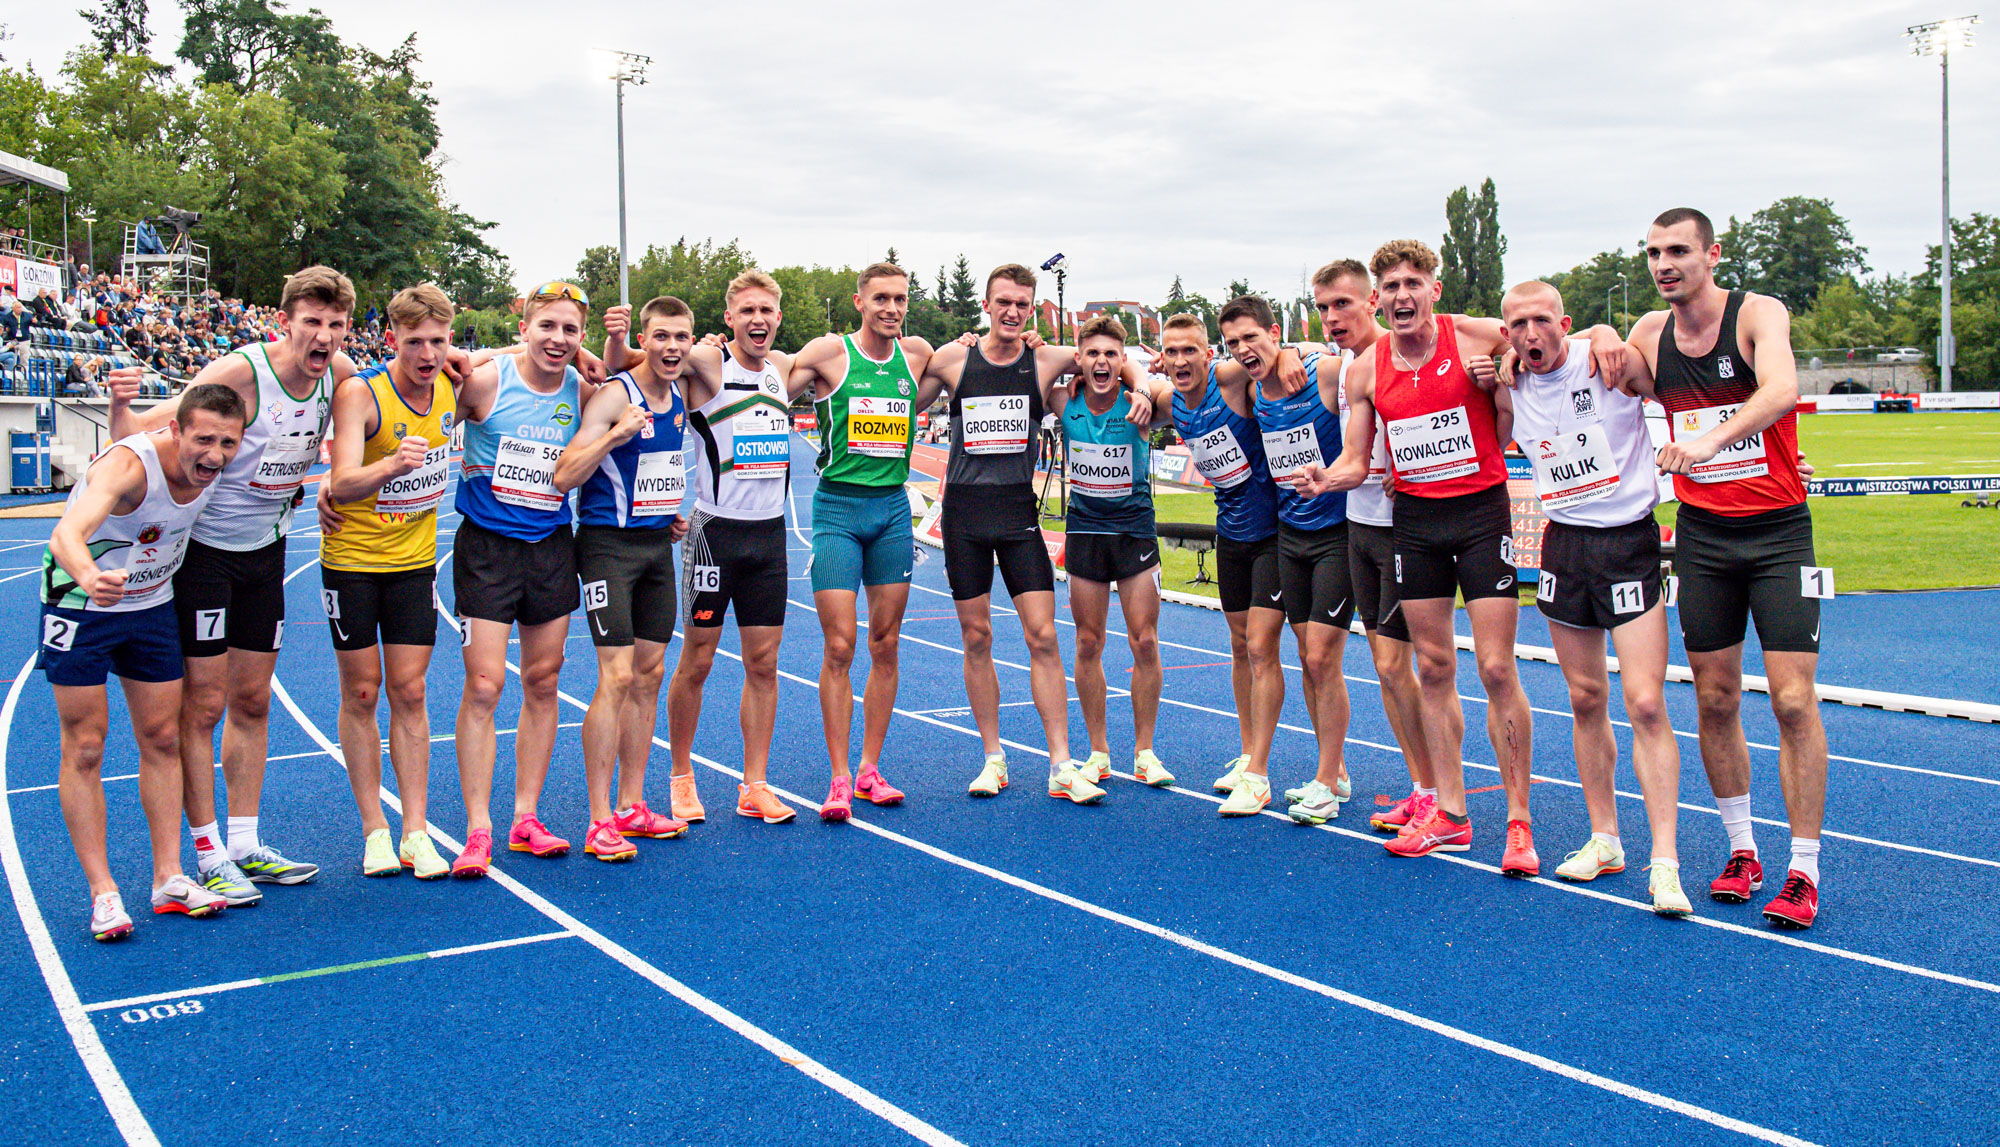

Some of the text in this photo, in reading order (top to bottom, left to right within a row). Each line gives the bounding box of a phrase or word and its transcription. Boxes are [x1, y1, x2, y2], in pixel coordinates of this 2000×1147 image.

[23, 266, 55, 286] GORZÓW
[886, 401, 906, 414] 100
[999, 399, 1023, 410] 610
[770, 419, 785, 431] 177
[853, 421, 906, 436] ROZMYS
[966, 419, 1027, 434] GROBERSKI
[1430, 412, 1460, 430] 295
[517, 425, 564, 442] GWDA
[1203, 431, 1227, 449] 283
[1286, 428, 1310, 444] 279
[1577, 433, 1587, 447] 9
[501, 440, 535, 455] Artisan
[736, 441, 789, 456] OSTROWSKI
[1103, 447, 1126, 458] 617
[1395, 434, 1471, 463] KOWALCZYK
[1540, 452, 1557, 460] ORLEN
[425, 448, 446, 465] 511
[669, 454, 683, 467] 480
[1269, 447, 1321, 470] KUCHARSKI
[1071, 461, 1130, 478] KOMODA
[1550, 456, 1599, 483] KULIK
[383, 468, 447, 494] BOROWSKI
[637, 476, 685, 492] WYDERKA
[1809, 482, 1825, 493] 99.
[1828, 481, 1852, 493] PZLA
[1856, 480, 1930, 492] MISTRZOSTWA
[1933, 479, 1969, 491] POLSKI
[1972, 479, 1984, 490] W
[695, 570, 718, 588] 16
[1540, 575, 1554, 597] 11
[1810, 569, 1824, 596] 1
[326, 591, 334, 616] 3
[585, 585, 606, 606] 15
[1616, 586, 1640, 608] 11
[49, 619, 69, 648] 2
[204, 612, 221, 638] 7
[120, 999, 205, 1024] 800
